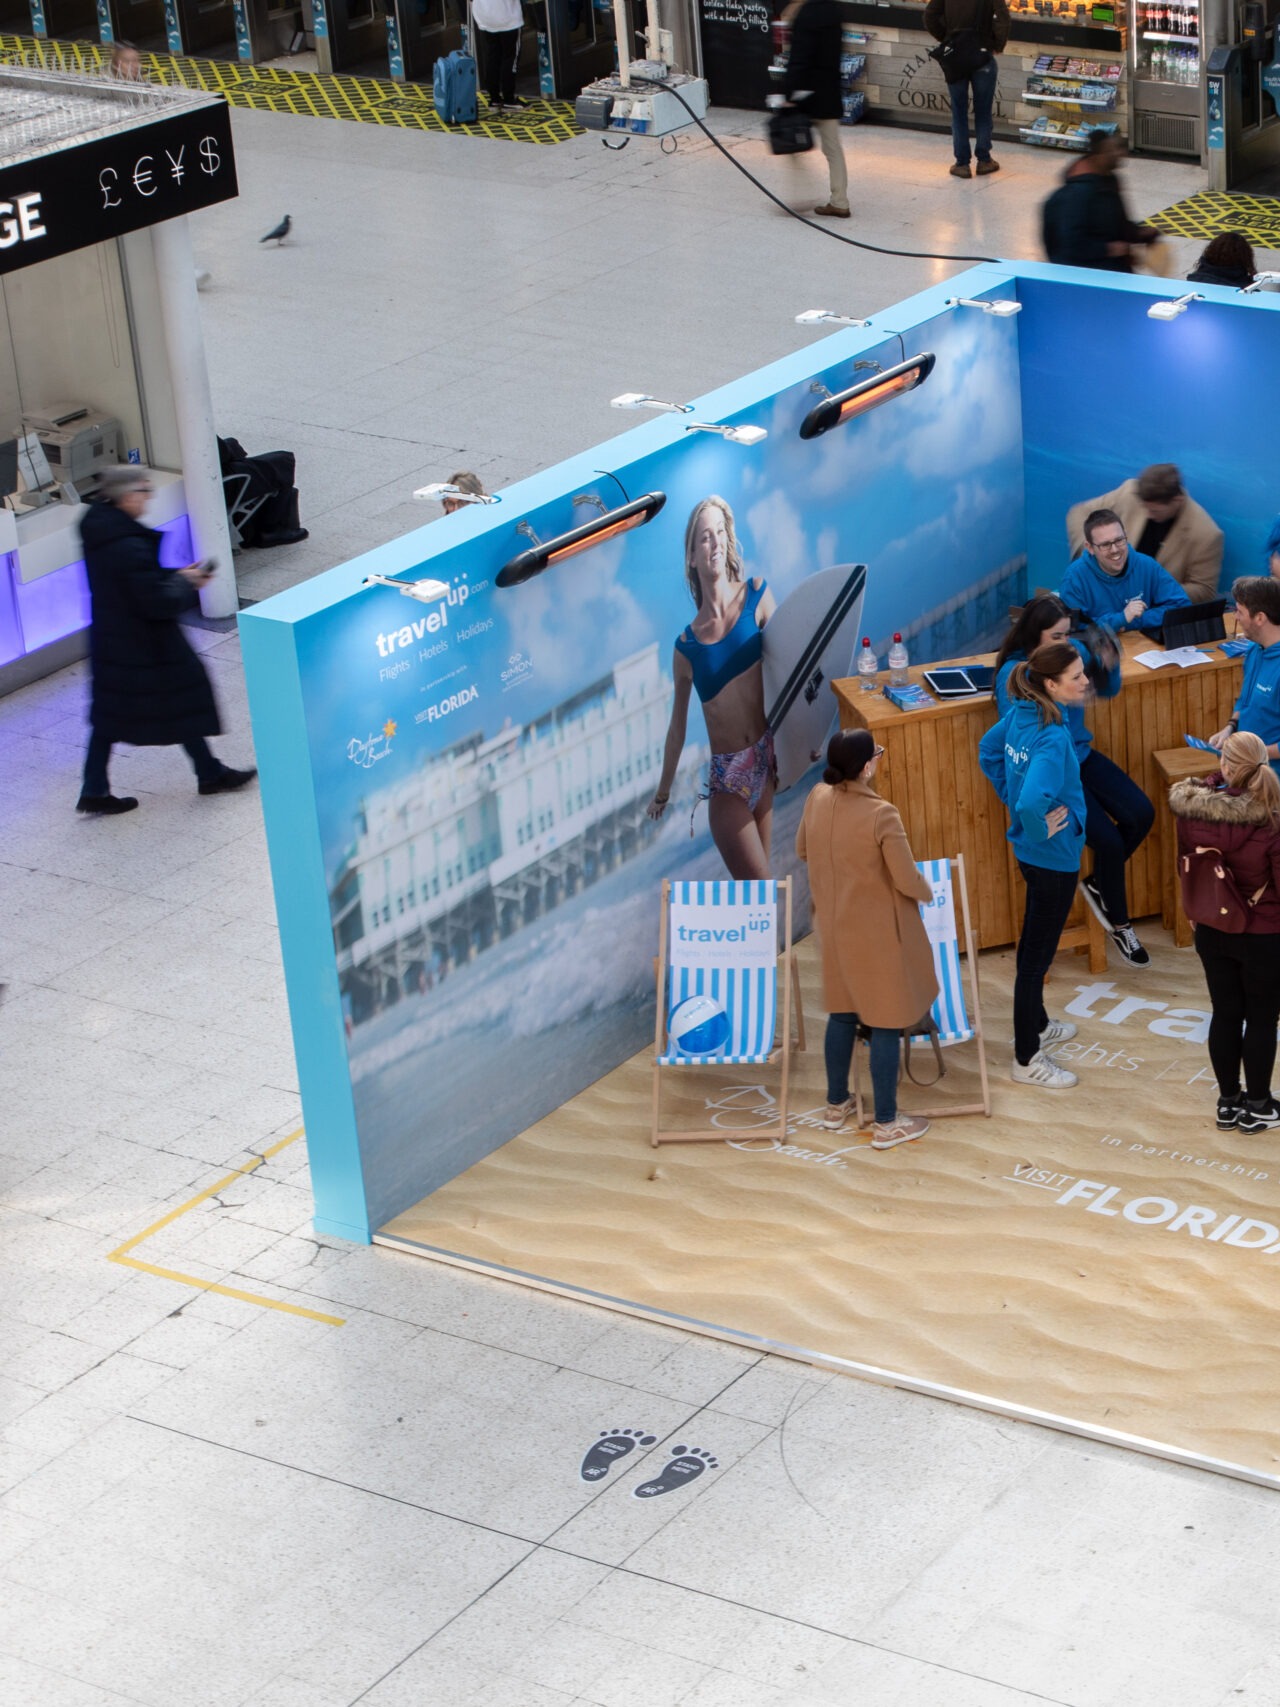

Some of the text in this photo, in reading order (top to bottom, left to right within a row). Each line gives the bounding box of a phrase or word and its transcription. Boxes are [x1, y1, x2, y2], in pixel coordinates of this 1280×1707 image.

[704, 10, 718, 20] with
[725, 11, 749, 30] hearty
[748, 14, 769, 33] filling
[743, 2, 768, 20] pastry
[898, 89, 1007, 118] CORNL
[99, 136, 220, 209] £ € ¥ $
[376, 602, 448, 657] travel
[379, 618, 494, 682] Flights Hotels Holidays
[500, 657, 533, 681] SIMON
[427, 685, 479, 723] FLORIDA
[677, 925, 746, 941] travel
[1100, 1134, 1122, 1147] in
[1129, 1141, 1269, 1182] partnership
[1012, 1163, 1076, 1188] VISIT
